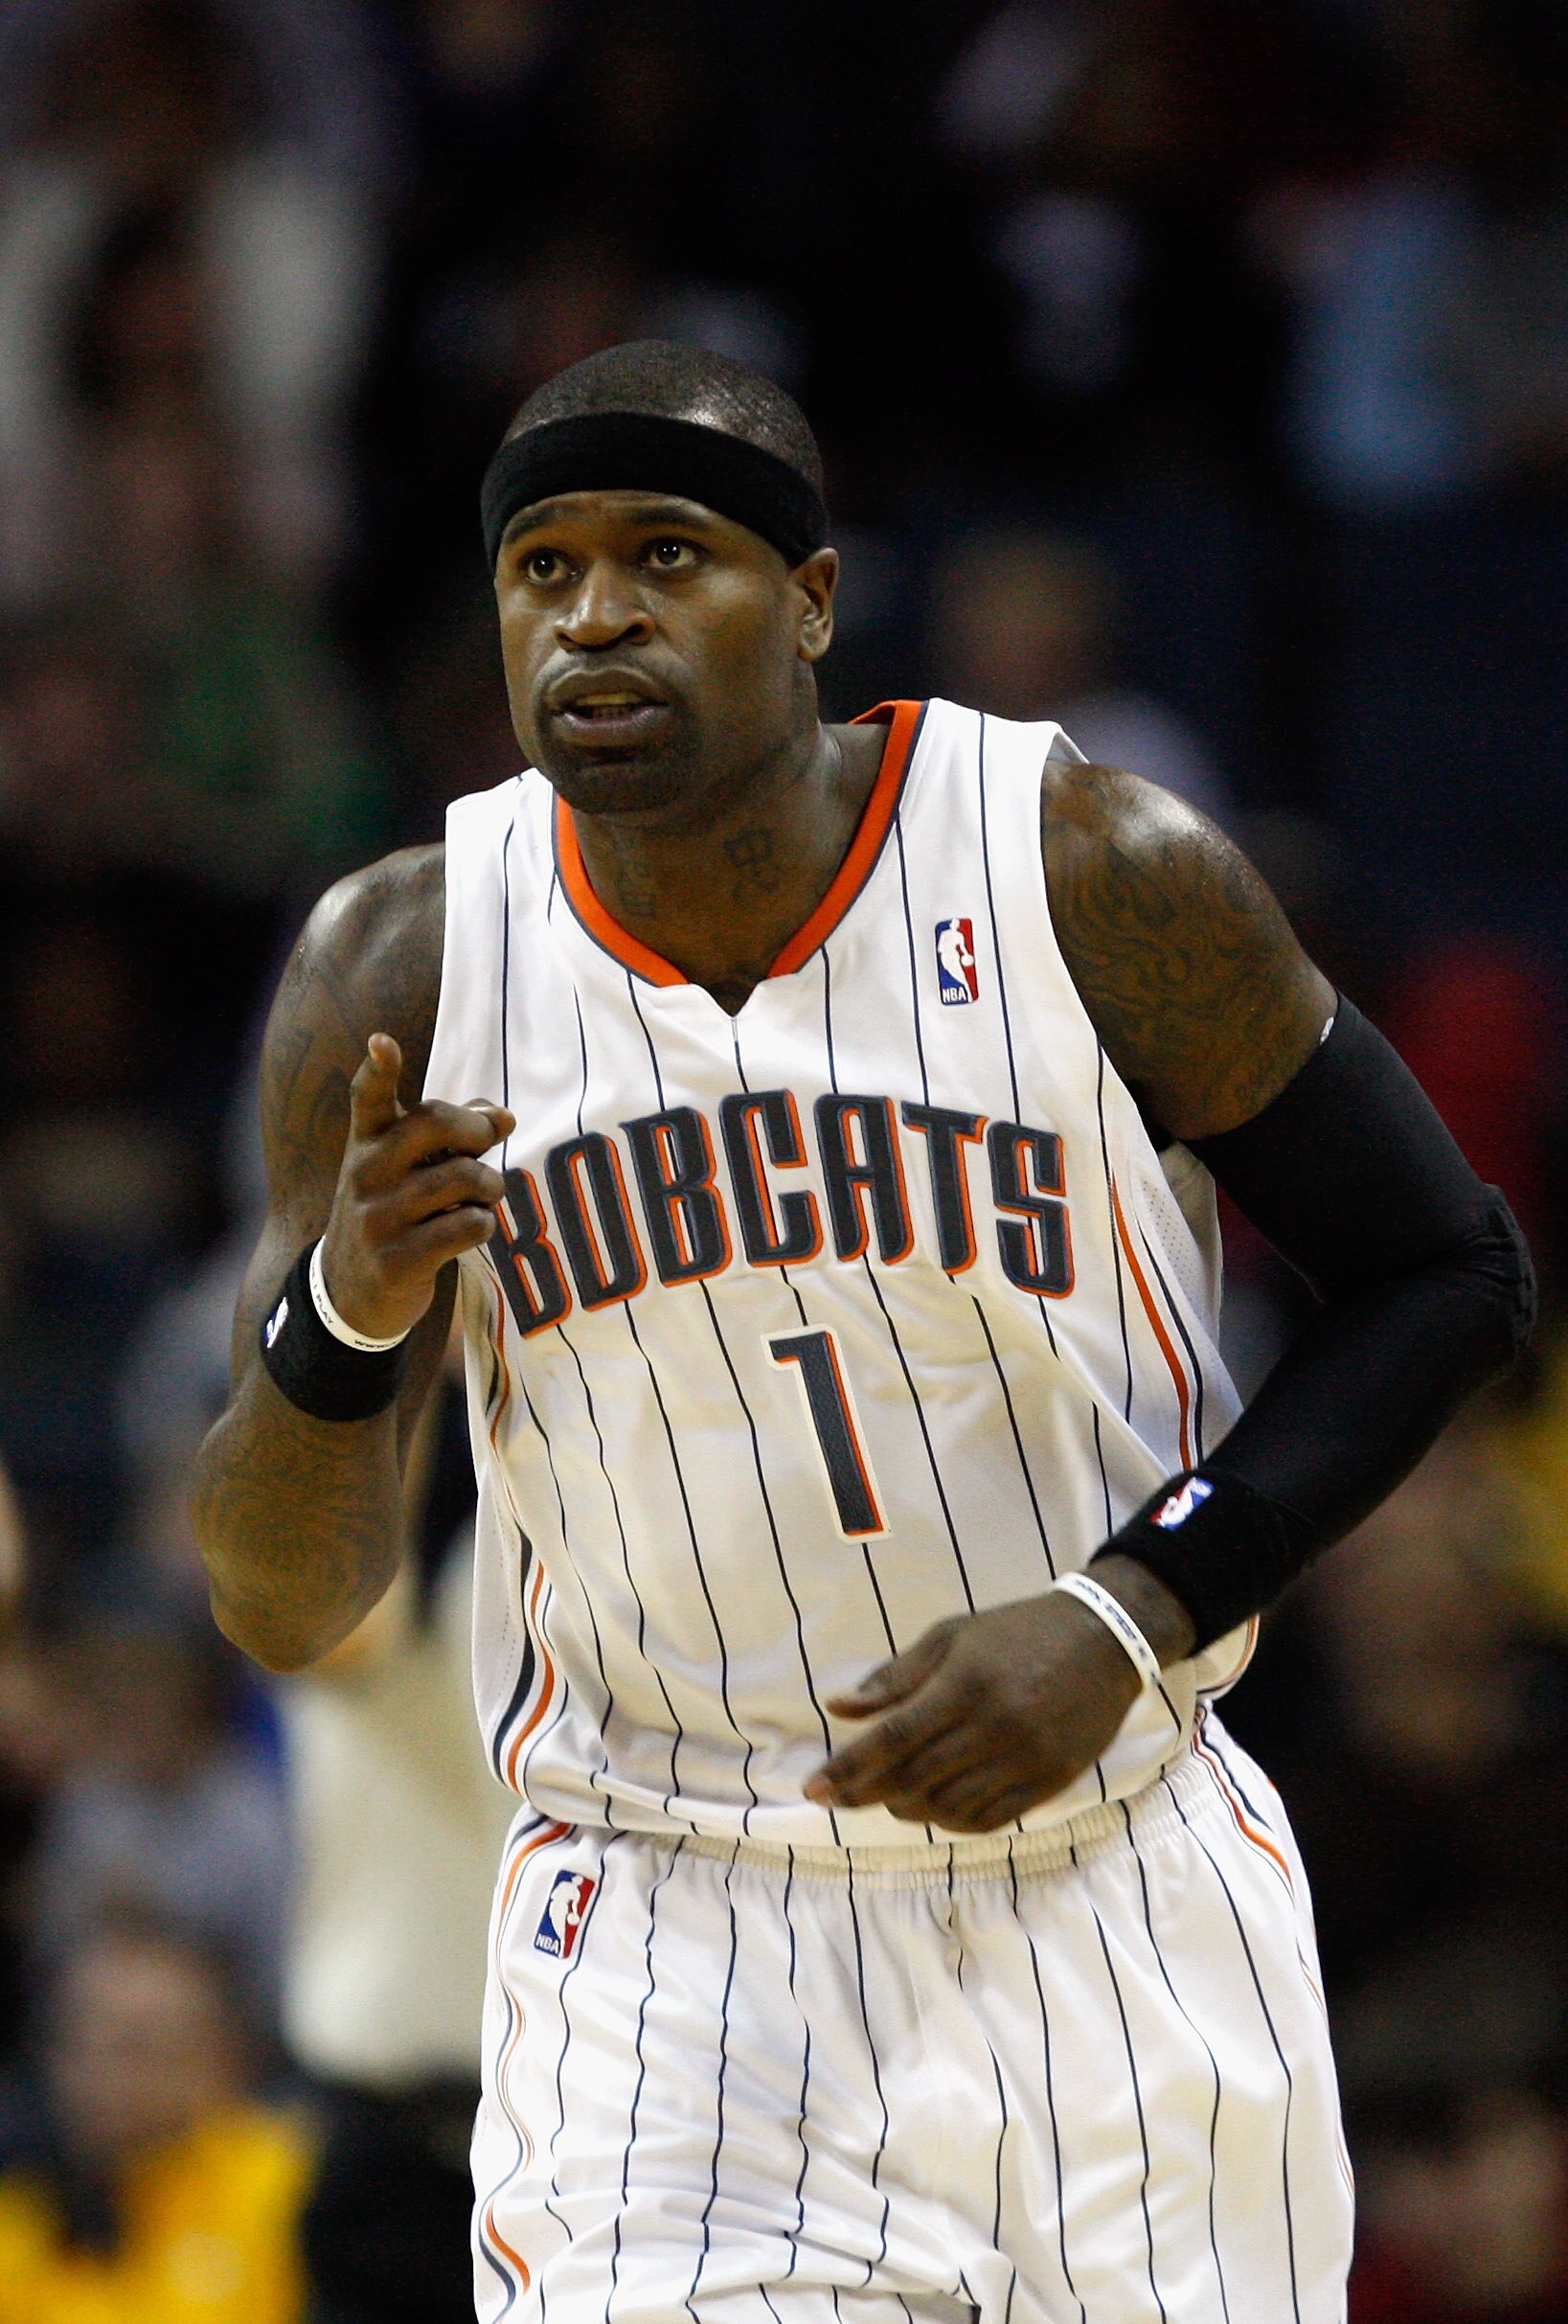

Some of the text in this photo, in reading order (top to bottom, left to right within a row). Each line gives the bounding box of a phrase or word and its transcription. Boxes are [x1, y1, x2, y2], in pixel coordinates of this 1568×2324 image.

[943, 987, 966, 1003] NBA
[488, 1088, 1077, 1339] BOBCATS
[767, 1329, 886, 1537] 1
[536, 1933, 559, 1954] NBA
